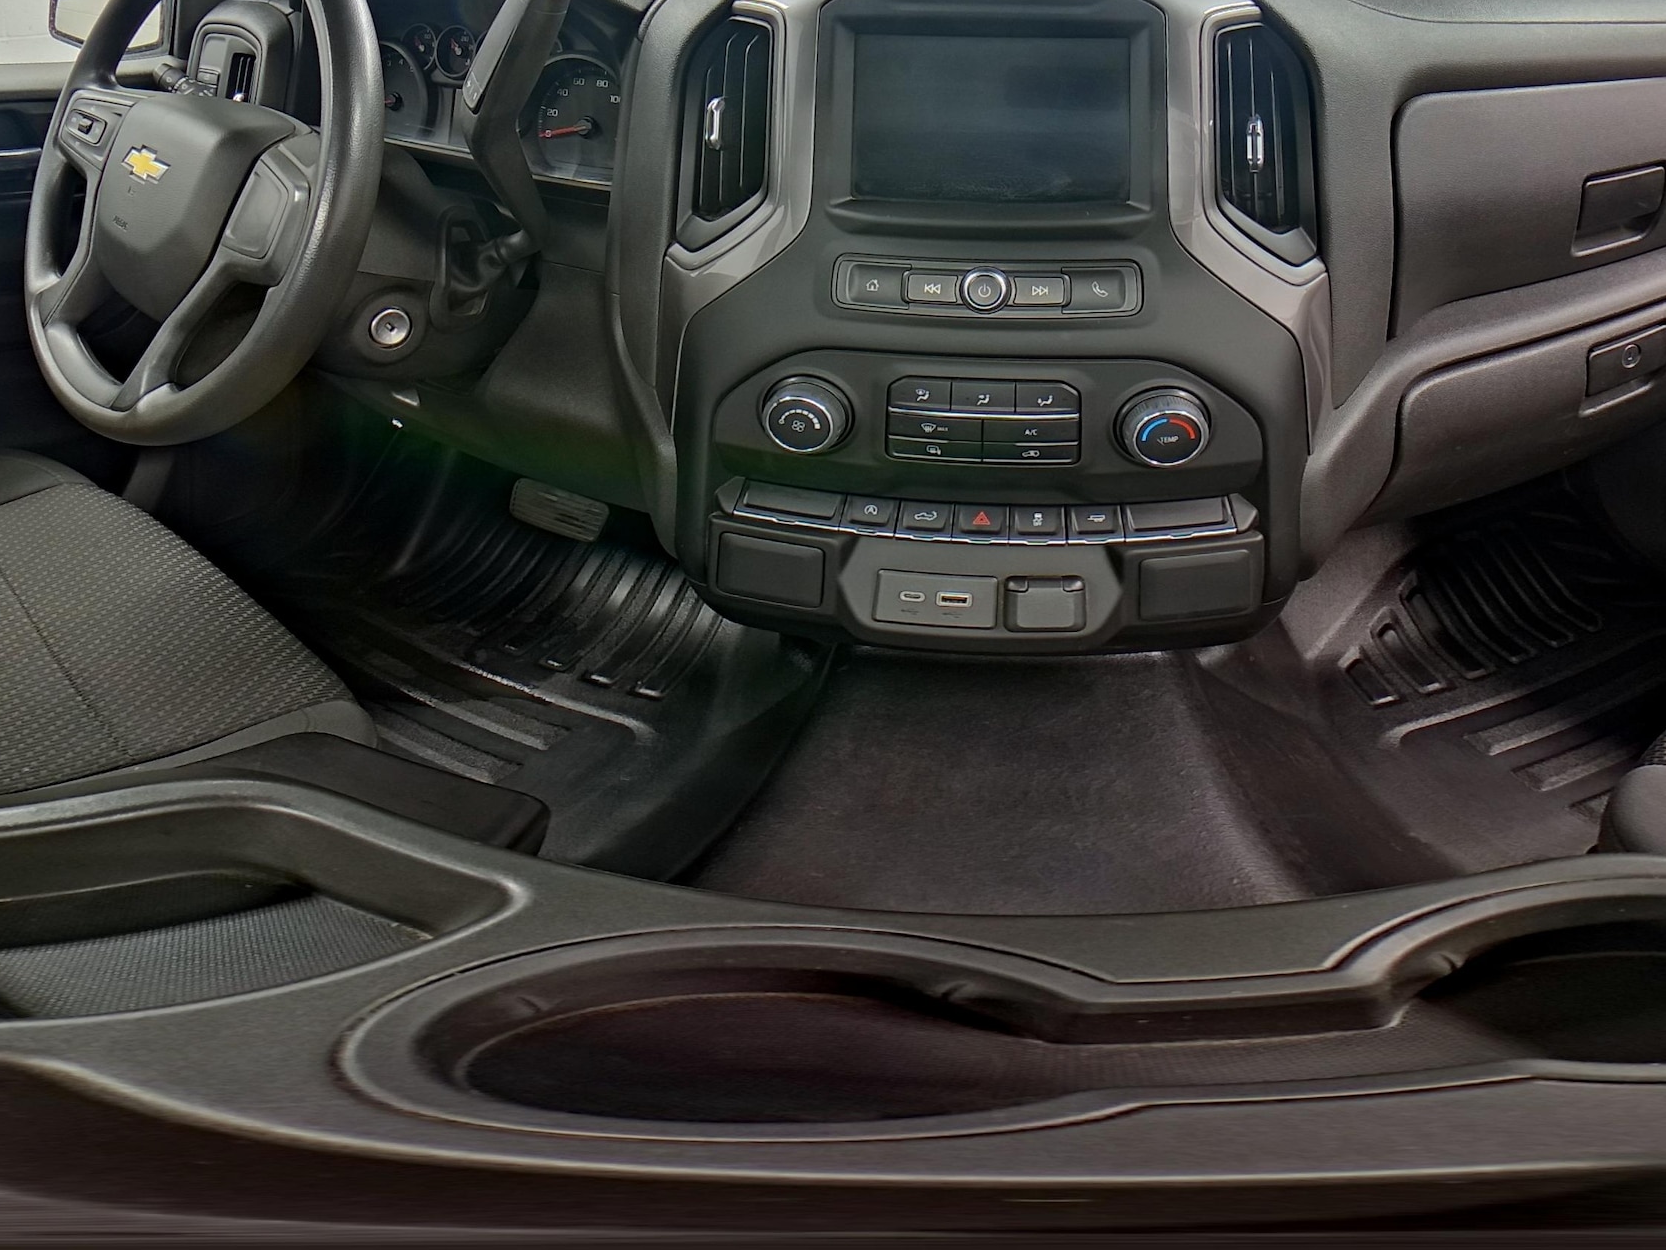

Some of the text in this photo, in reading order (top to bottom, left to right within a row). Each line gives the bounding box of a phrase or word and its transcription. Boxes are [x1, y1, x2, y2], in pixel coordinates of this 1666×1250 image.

[573, 78, 585, 86] 60
[596, 79, 609, 88] 80
[556, 88, 569, 97] 40
[546, 108, 559, 117] 20
[1159, 435, 1179, 444] TEMP
